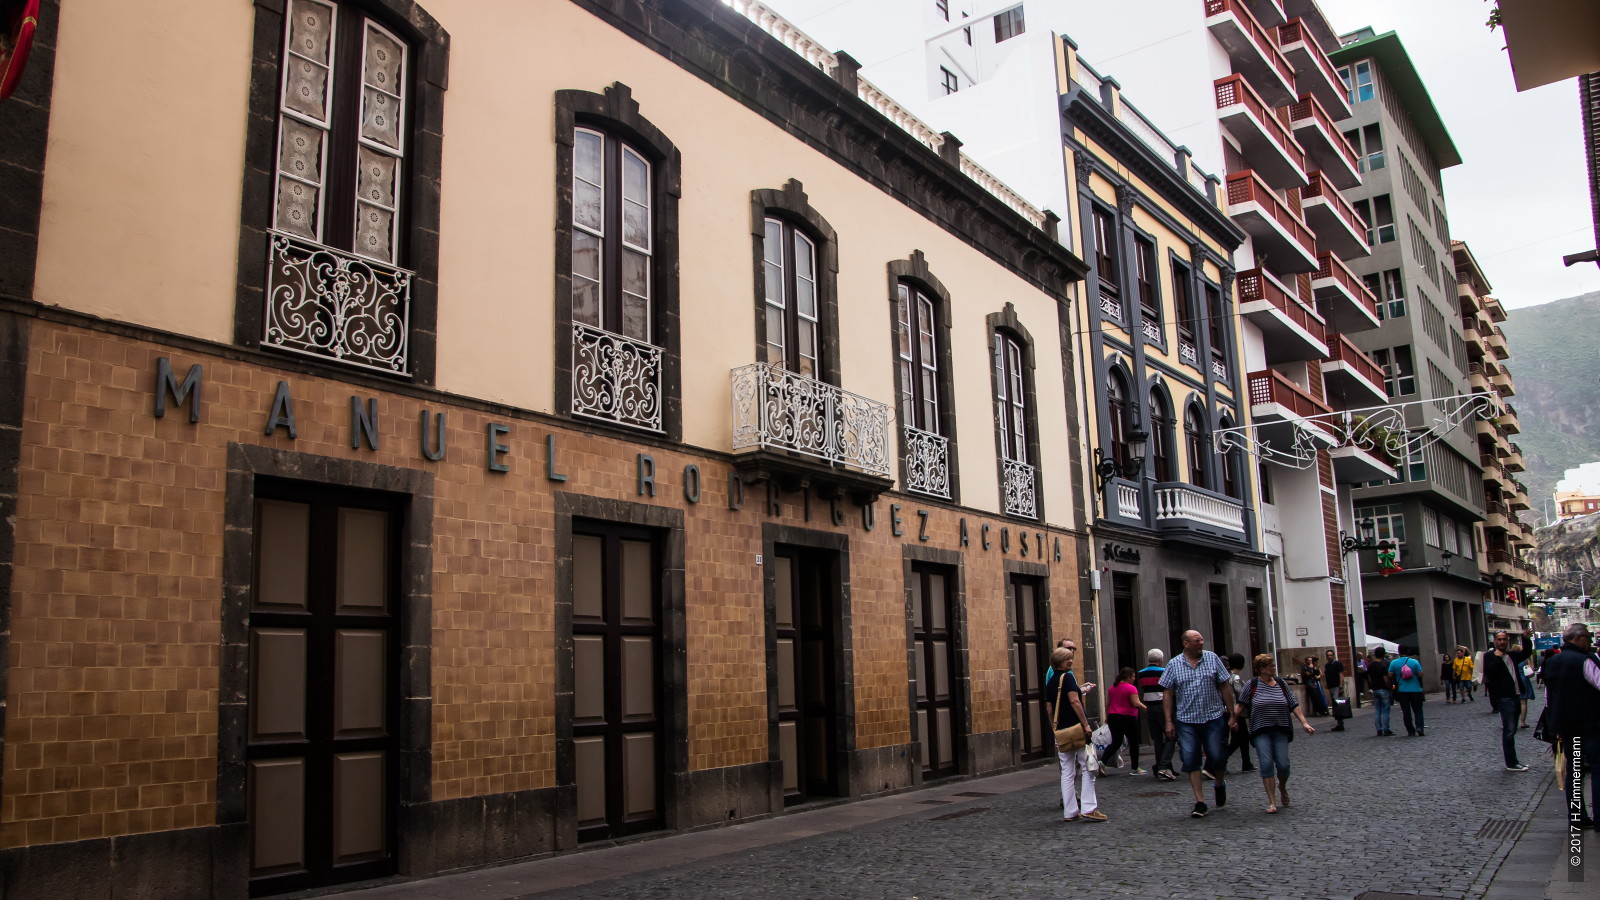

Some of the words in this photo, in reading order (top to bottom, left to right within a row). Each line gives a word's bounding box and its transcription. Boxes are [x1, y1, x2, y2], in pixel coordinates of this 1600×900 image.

[154, 356, 568, 482] MANUEL
[637, 453, 930, 542] RODRIGUEZ
[959, 517, 1062, 562] ACOSTA
